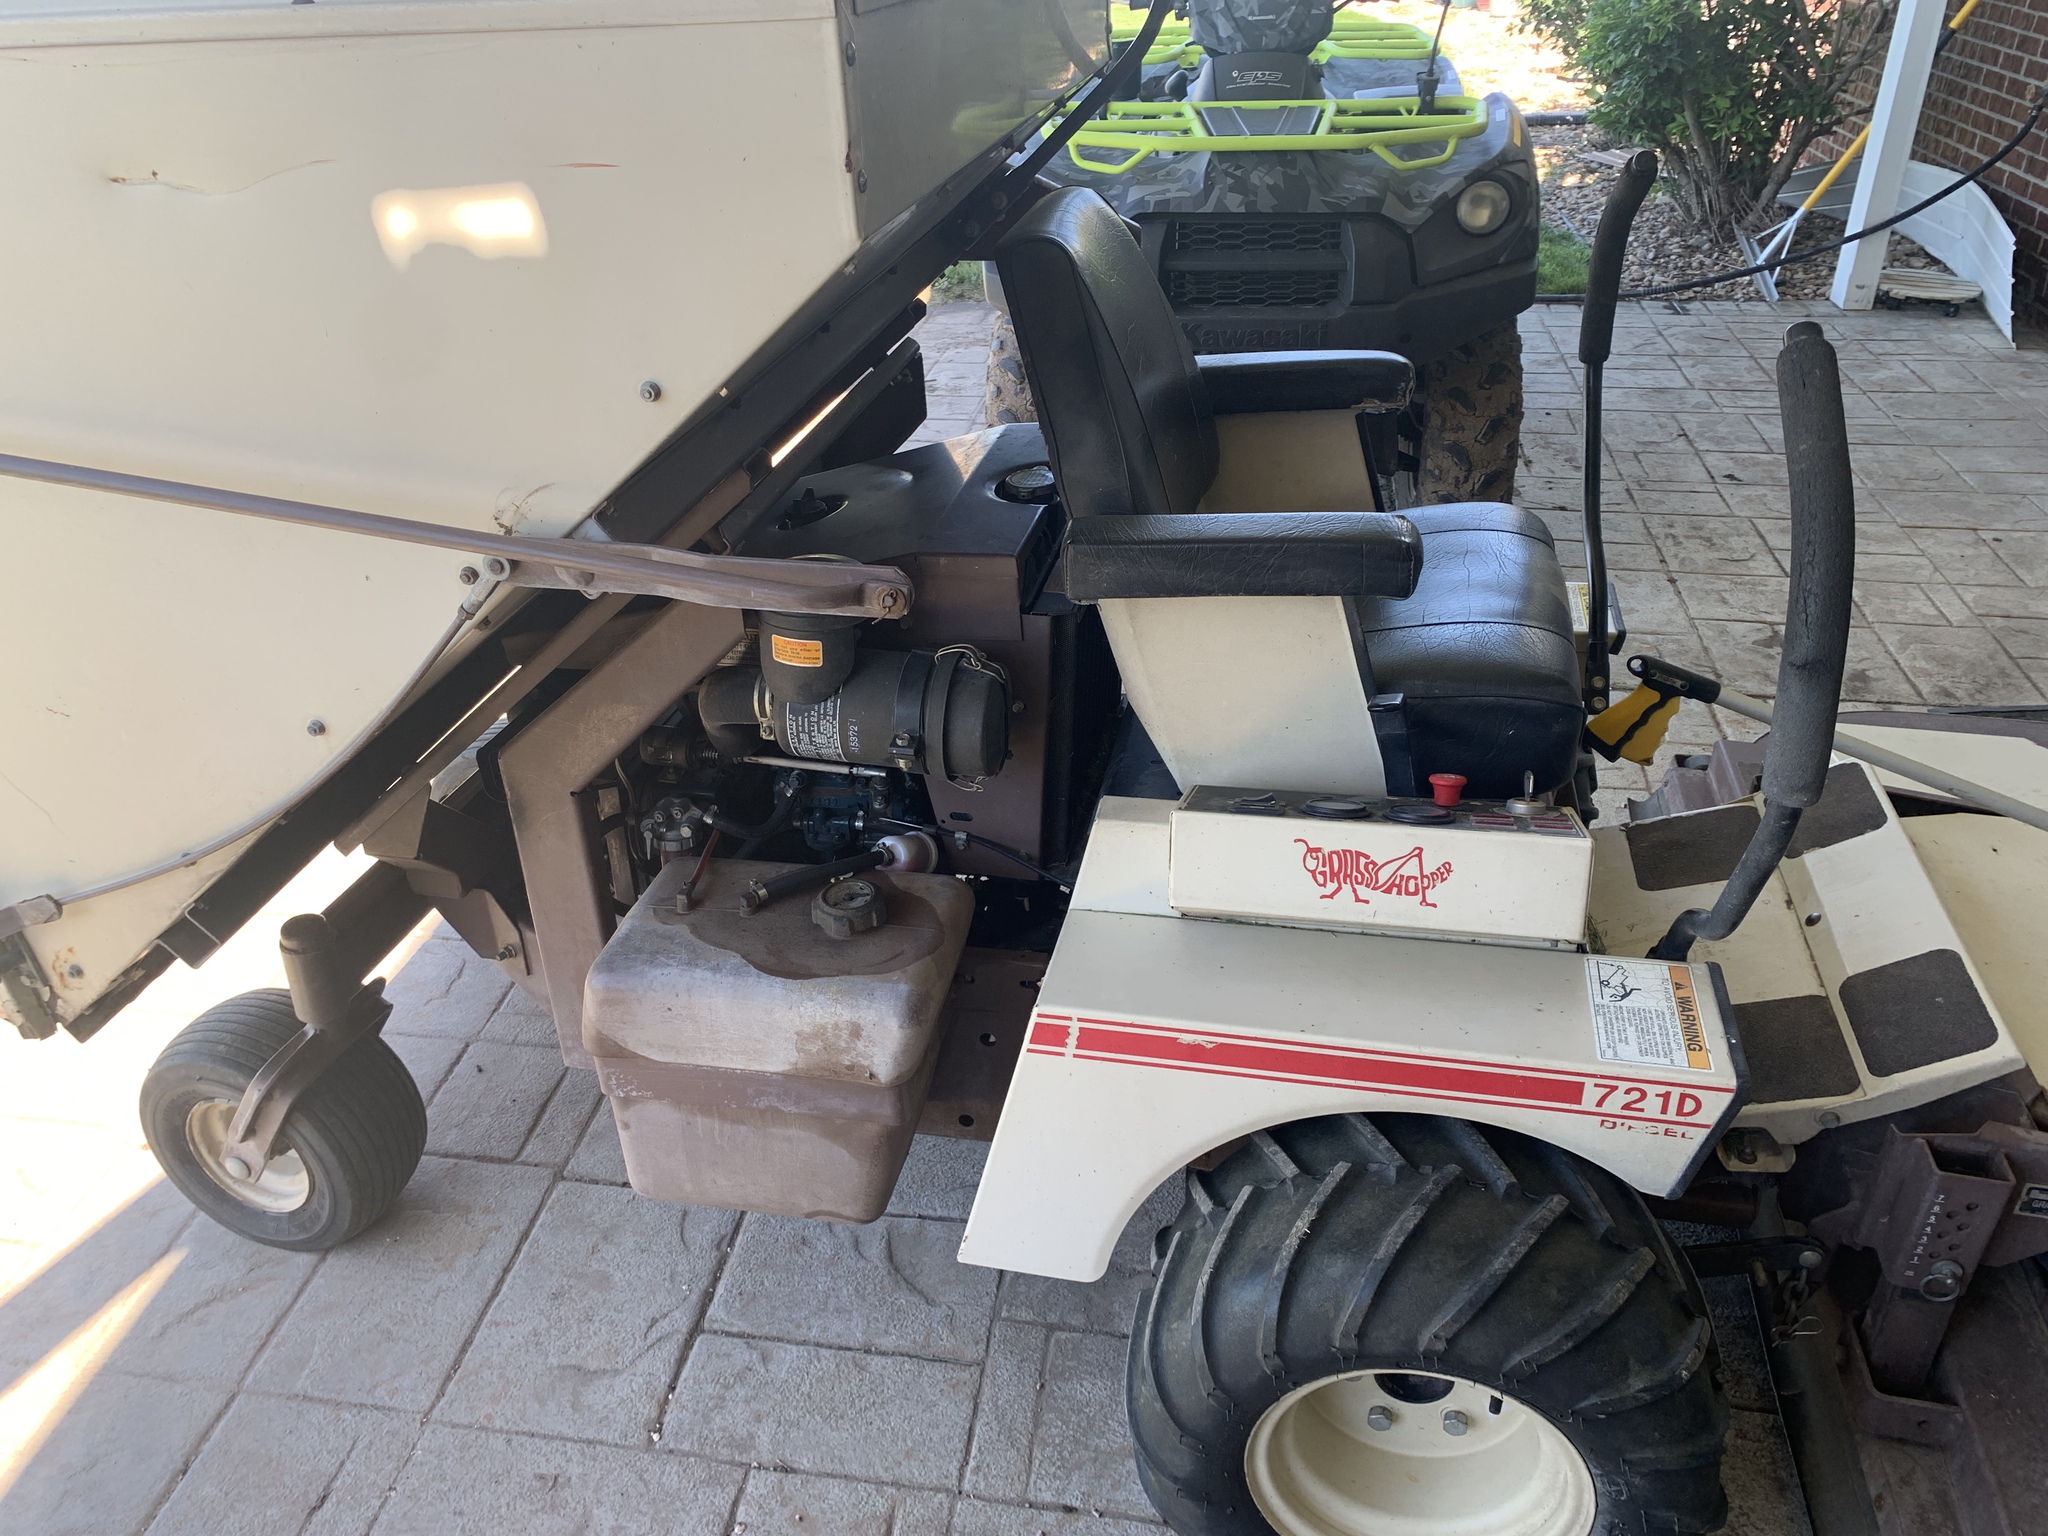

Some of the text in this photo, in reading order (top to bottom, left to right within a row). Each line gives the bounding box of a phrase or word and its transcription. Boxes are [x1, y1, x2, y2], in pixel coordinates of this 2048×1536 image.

[1237, 71, 1282, 82] EPS
[1180, 322, 1328, 348] Kawasaki
[1294, 838, 1454, 908] GRASSHOPPER
[1664, 986, 1673, 1004] AVOID
[1667, 1004, 1679, 1030] SERIOUS
[1677, 996, 1703, 1052] WARNING
[1593, 1082, 1703, 1117] 721D
